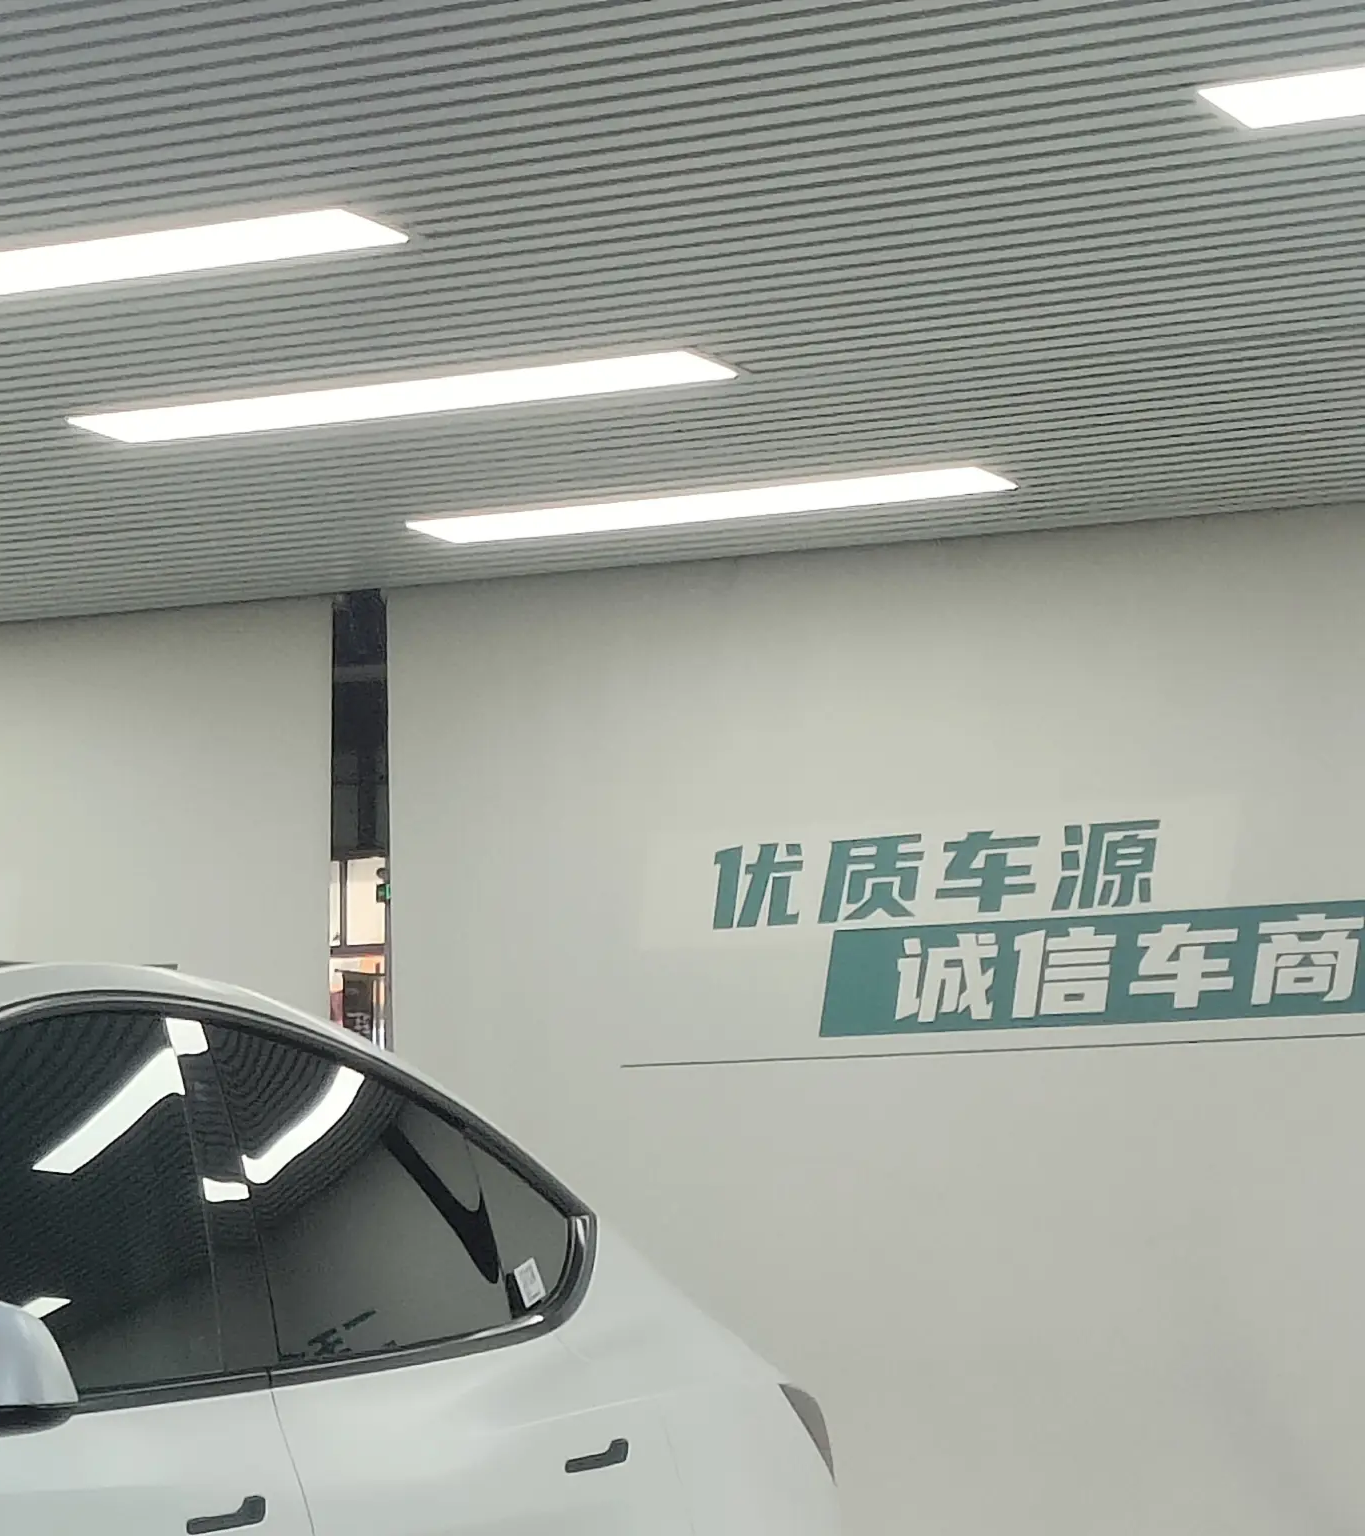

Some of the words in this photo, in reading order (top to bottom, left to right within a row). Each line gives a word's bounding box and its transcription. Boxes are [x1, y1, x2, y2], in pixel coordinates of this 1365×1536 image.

[712, 817, 1162, 930] 优质车源
[893, 912, 1365, 1024] 诚信车商
